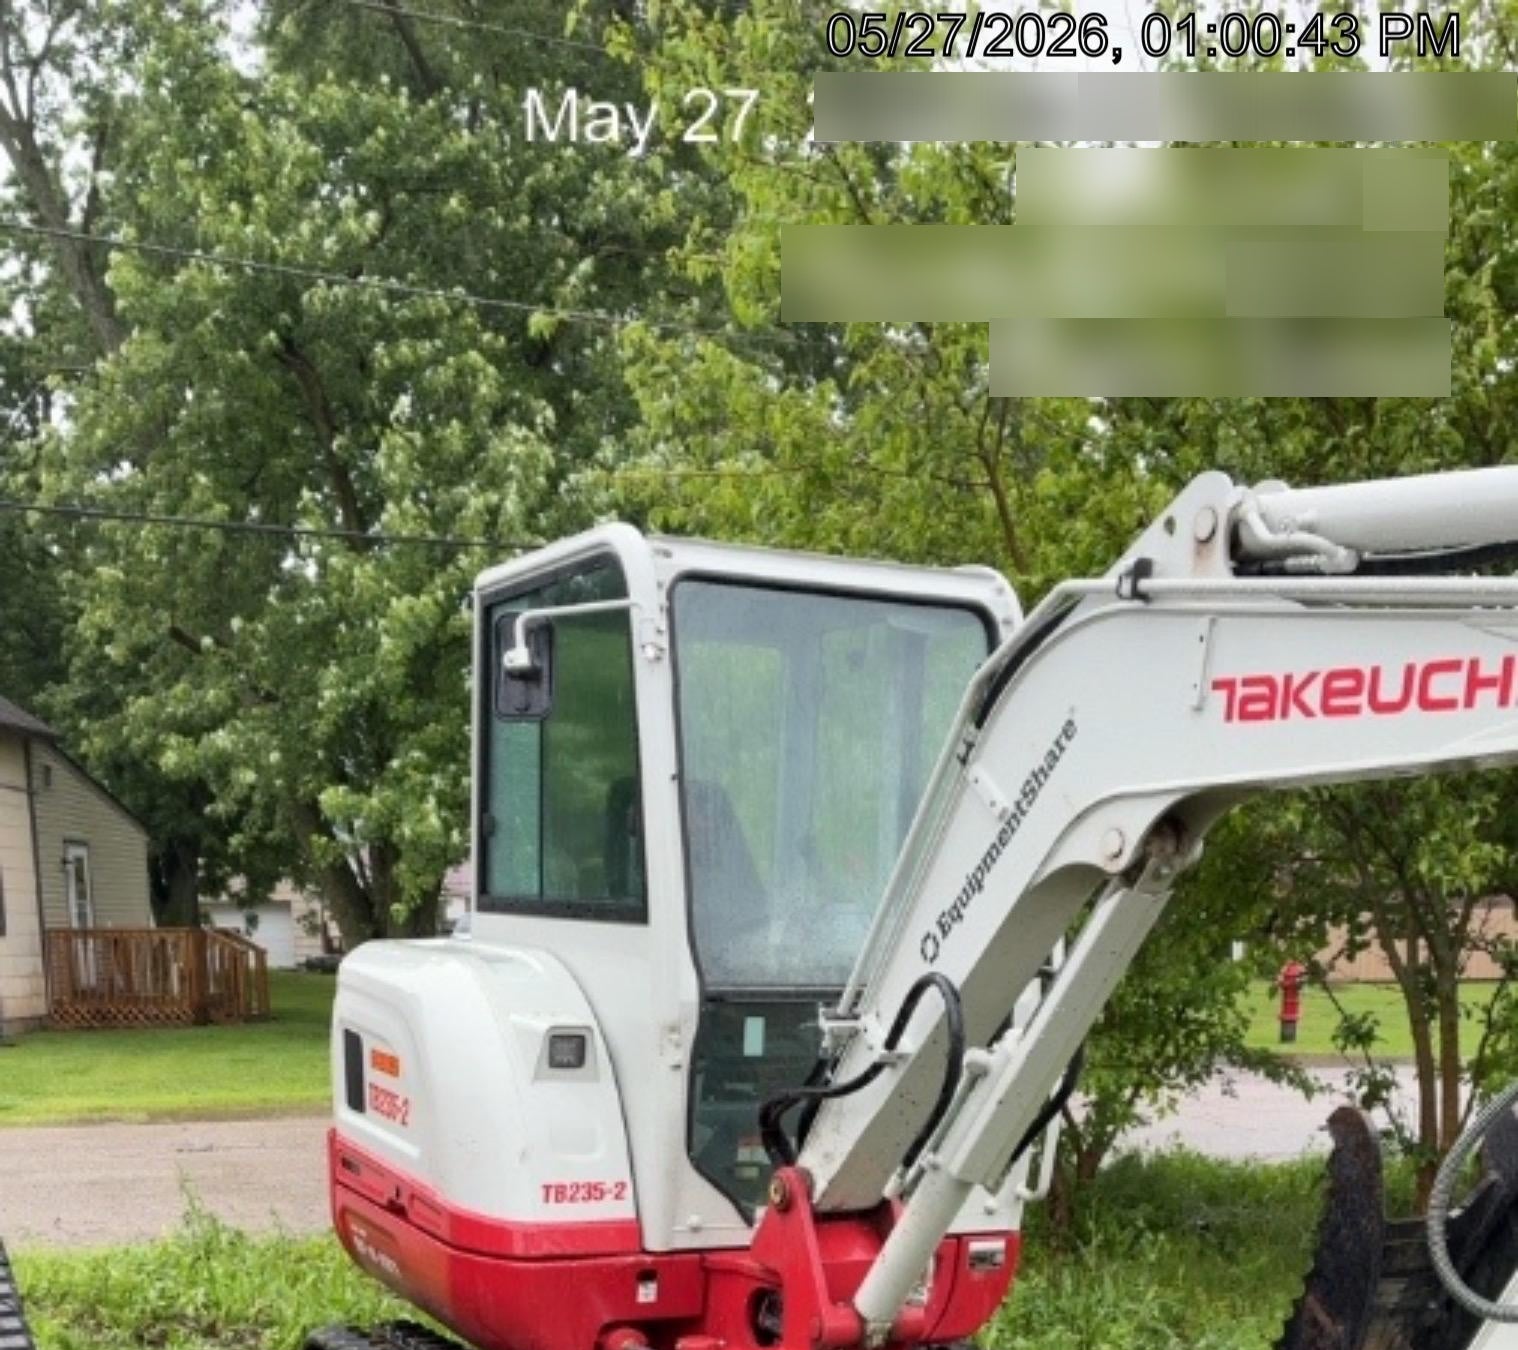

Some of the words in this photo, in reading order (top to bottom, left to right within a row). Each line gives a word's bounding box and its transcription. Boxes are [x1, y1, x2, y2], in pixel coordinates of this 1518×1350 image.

[1211, 656, 1518, 723] TAKEUCH
[936, 718, 1078, 940] EquipmentShare
[541, 1181, 627, 1203] TB235-2
